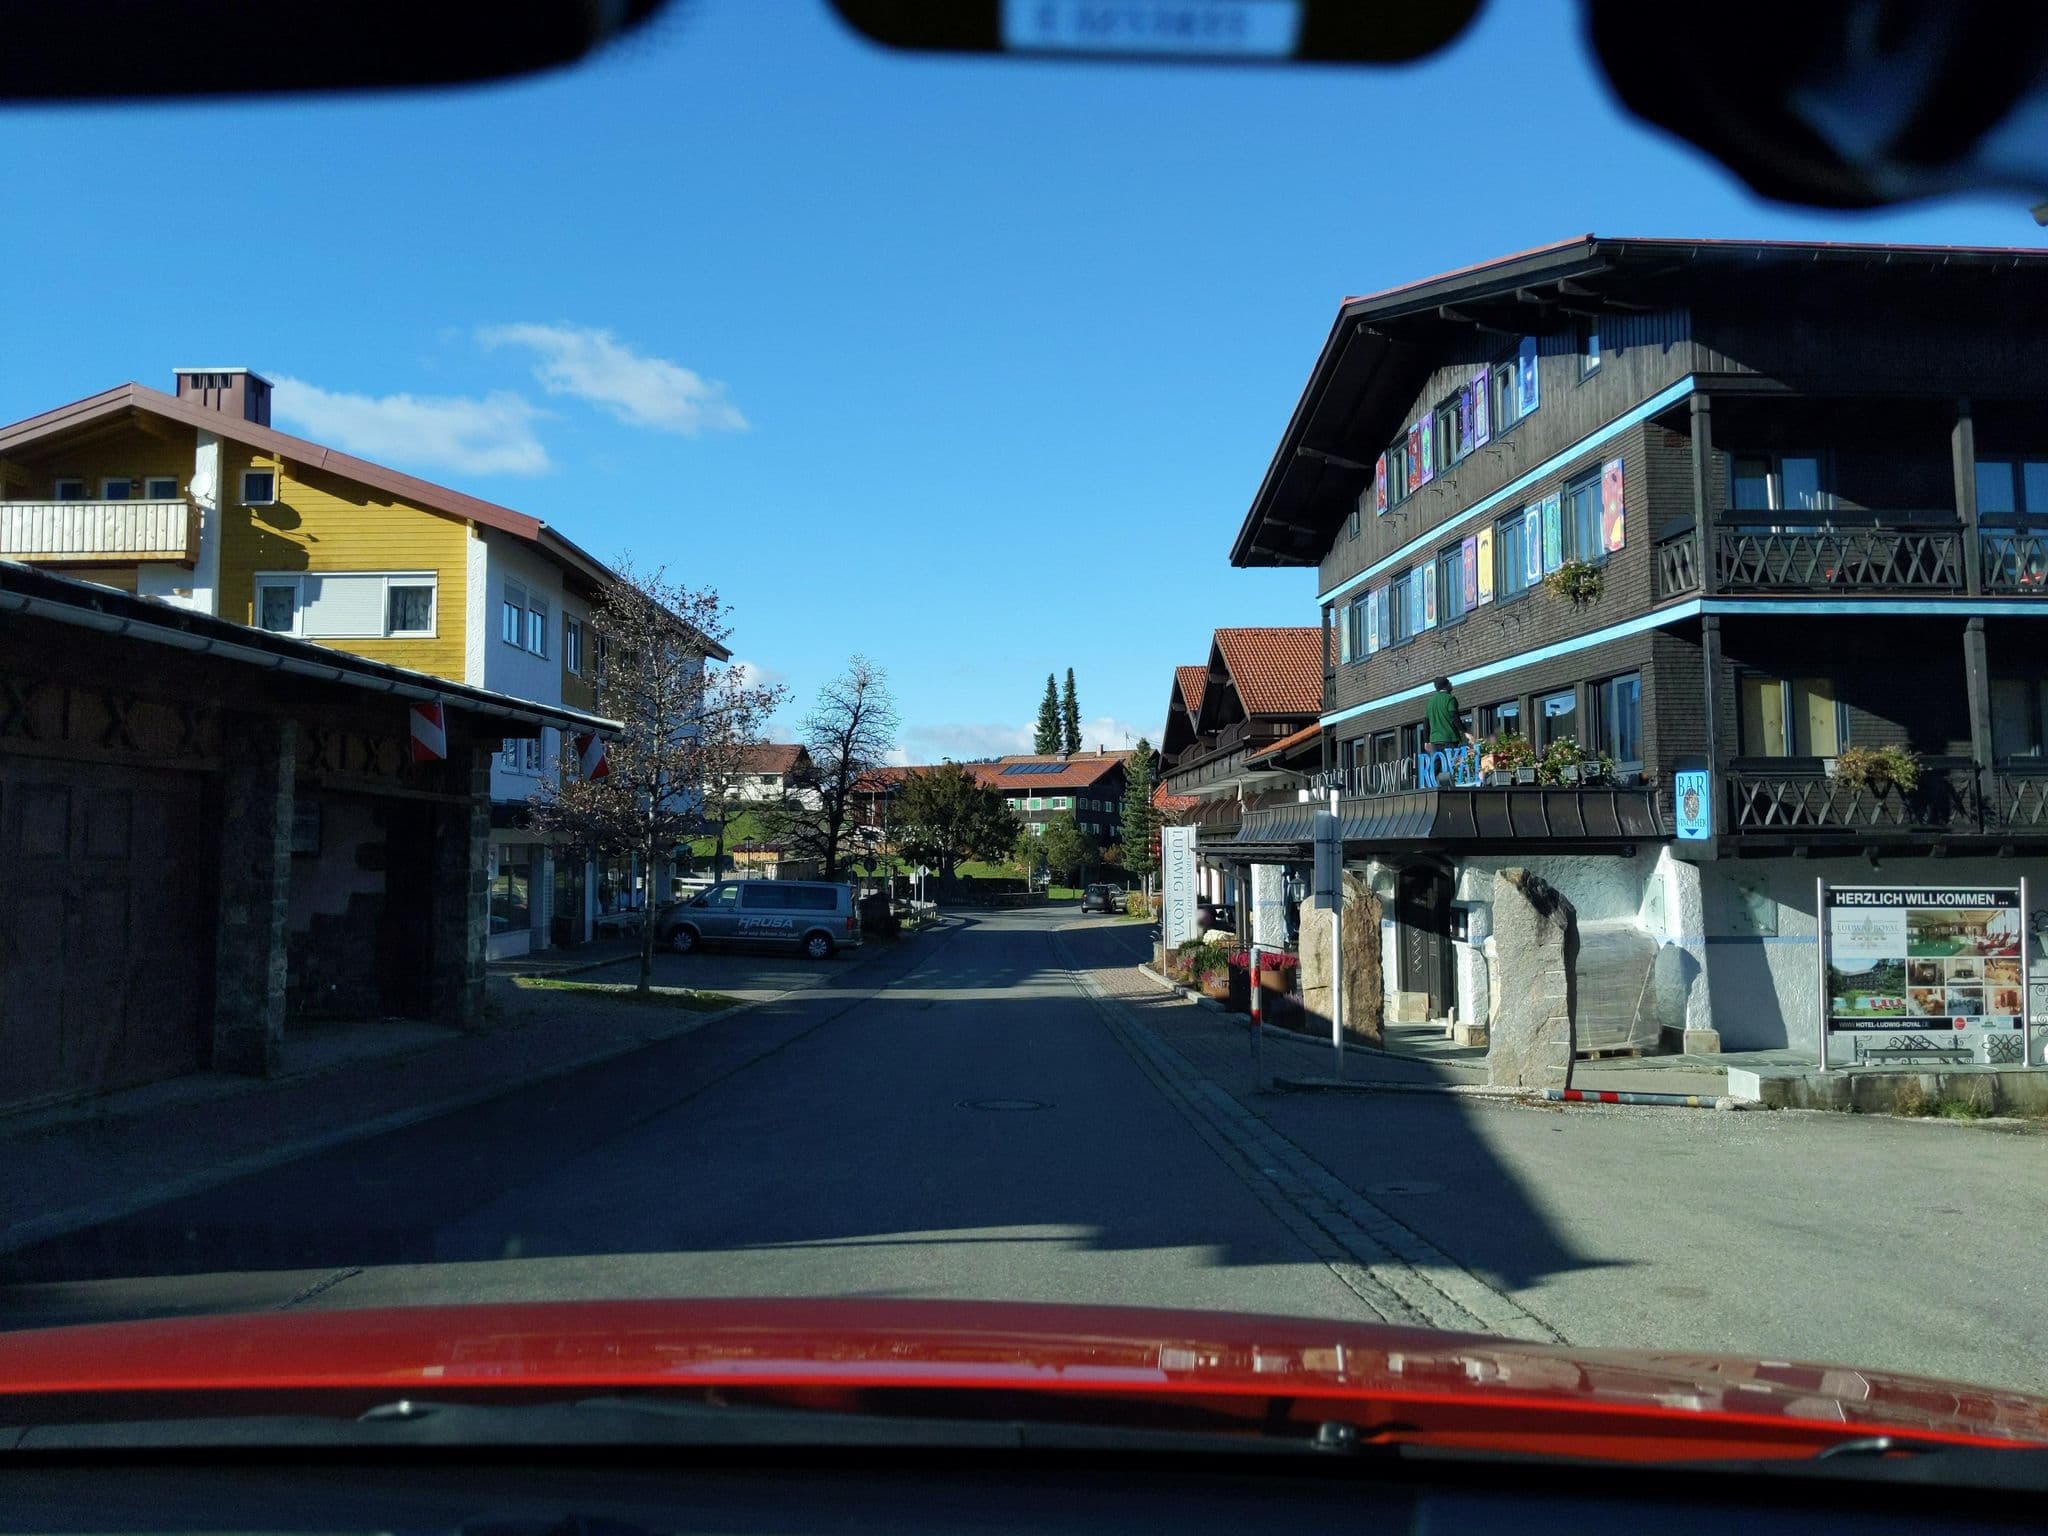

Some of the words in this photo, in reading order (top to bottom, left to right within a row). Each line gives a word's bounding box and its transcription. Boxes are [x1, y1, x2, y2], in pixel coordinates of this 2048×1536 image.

[1418, 743, 1481, 789] ROYAL
[1678, 775, 1706, 797] BAR
[1173, 830, 1184, 892] LUDWIG
[1836, 892, 1903, 905] HERZLICH
[1905, 893, 1995, 905] WILLKOMMEN
[1174, 899, 1185, 948] ROYAL
